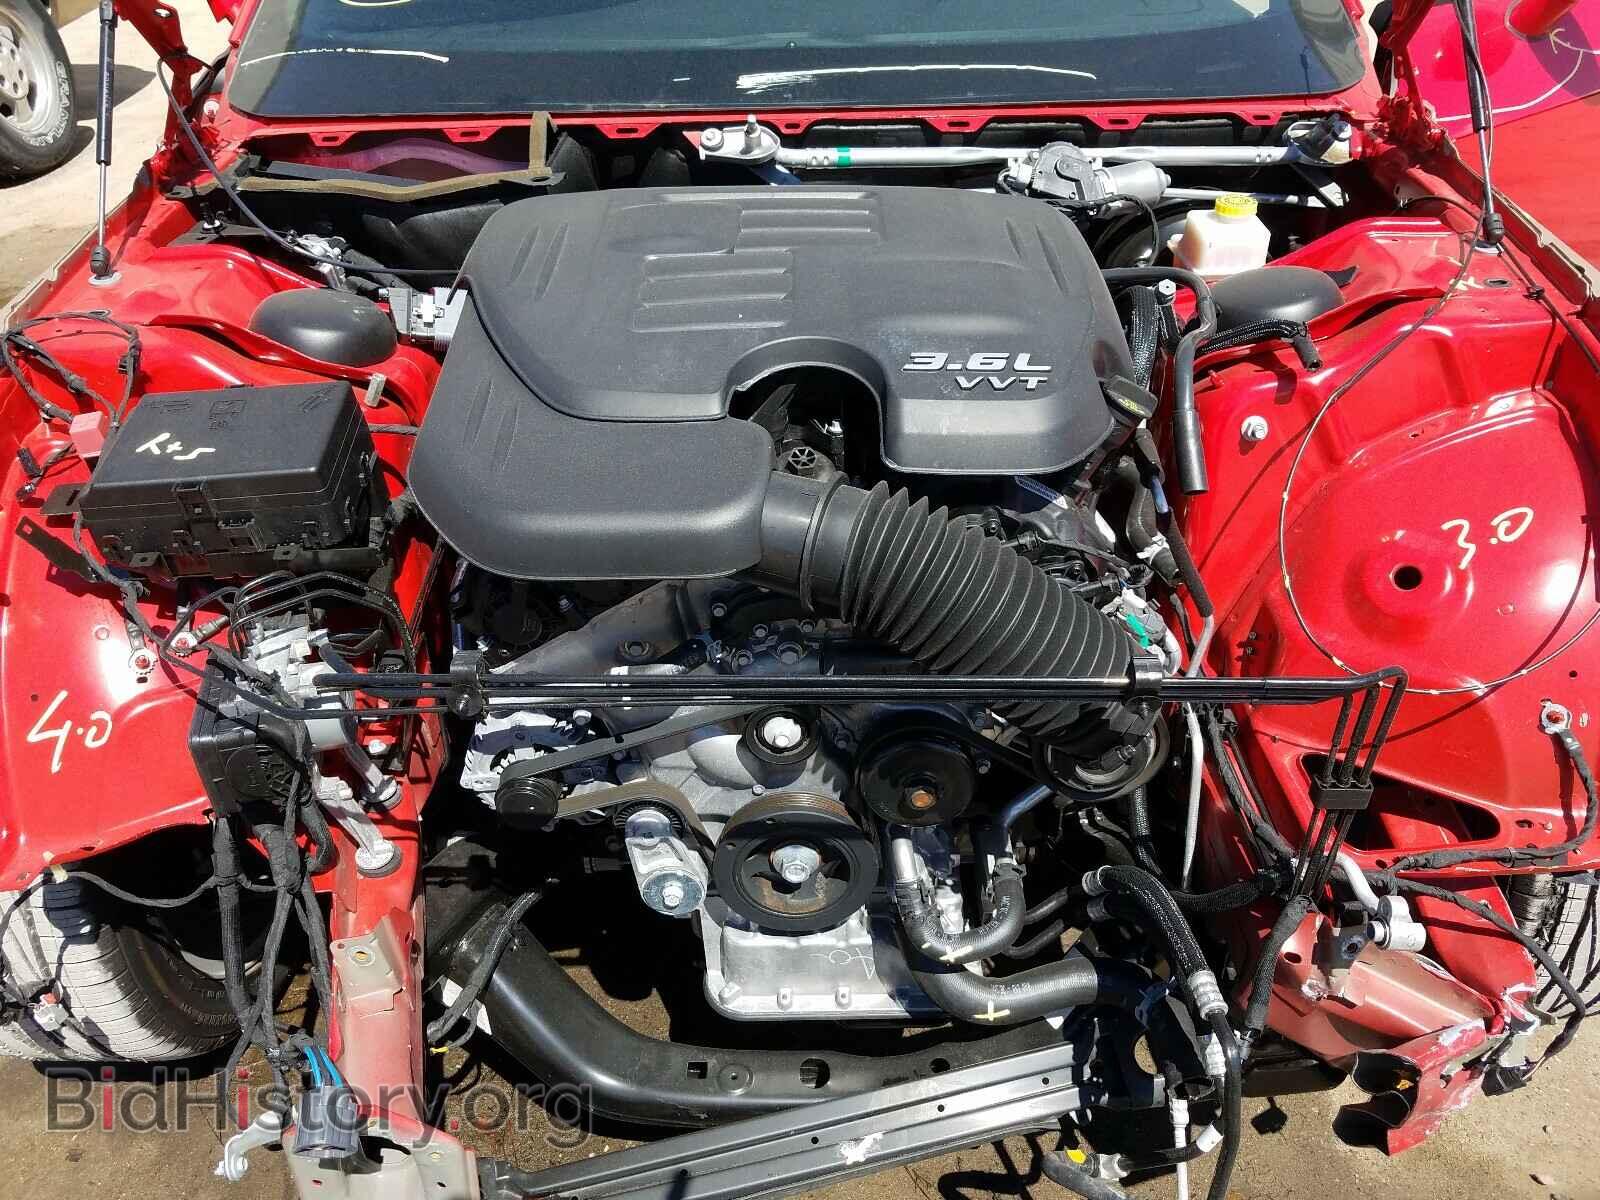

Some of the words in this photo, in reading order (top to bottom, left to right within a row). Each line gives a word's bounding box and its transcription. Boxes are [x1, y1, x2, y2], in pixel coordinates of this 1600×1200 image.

[901, 352, 1052, 372] 3.6L
[955, 375, 1048, 392] VVT
[1440, 506, 1535, 570] 3.0
[26, 689, 113, 774] 4.0
